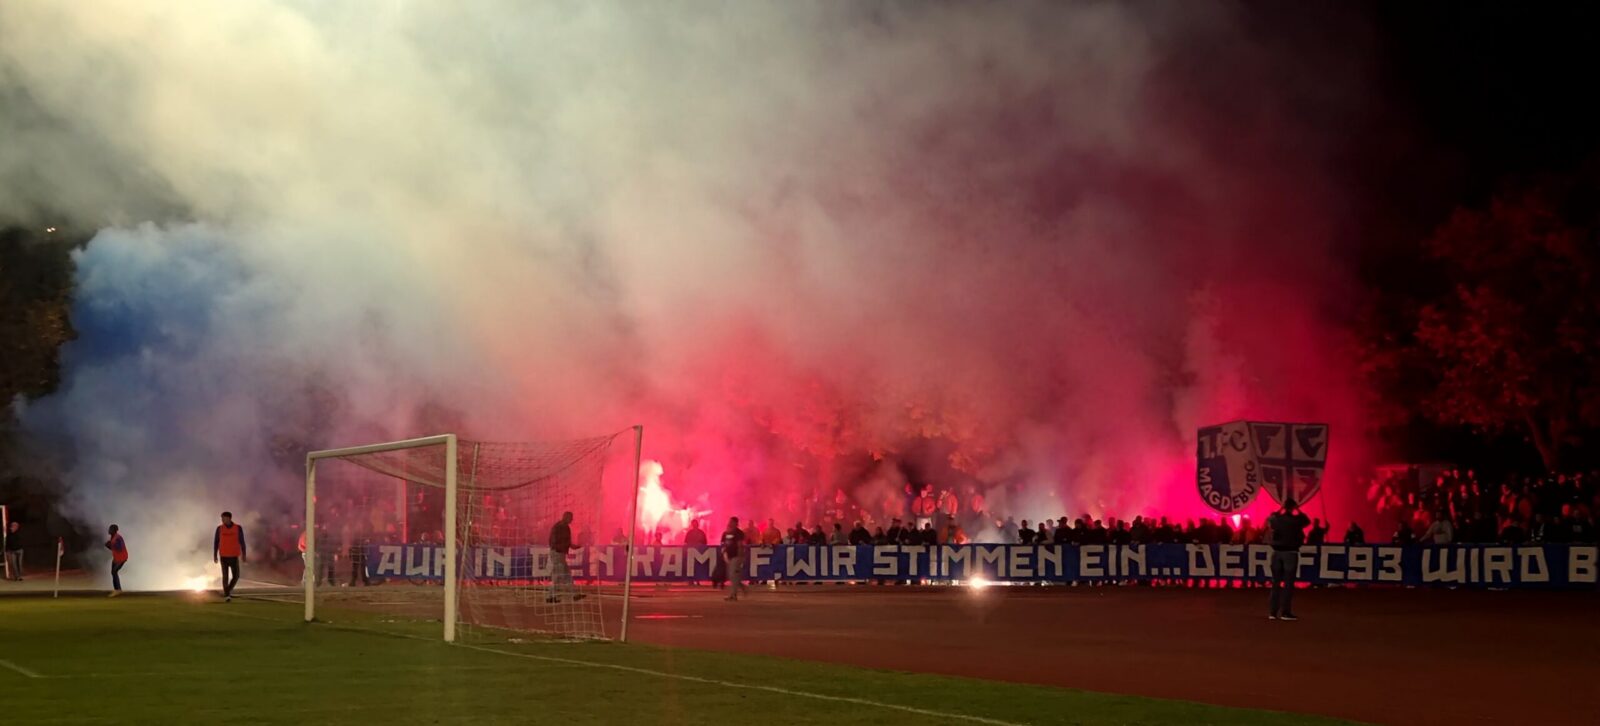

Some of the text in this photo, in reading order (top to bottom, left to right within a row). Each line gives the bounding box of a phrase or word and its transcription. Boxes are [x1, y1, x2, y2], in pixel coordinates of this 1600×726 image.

[1198, 459, 1257, 511] MAGDEBURG
[474, 546, 512, 577] IN
[630, 545, 782, 580] KAMF,
[786, 546, 856, 577] WIR
[873, 544, 1063, 577] STIMMEN
[1185, 543, 1273, 577] DER
[1295, 545, 1403, 581] FC93
[1421, 546, 1550, 583] WIRD
